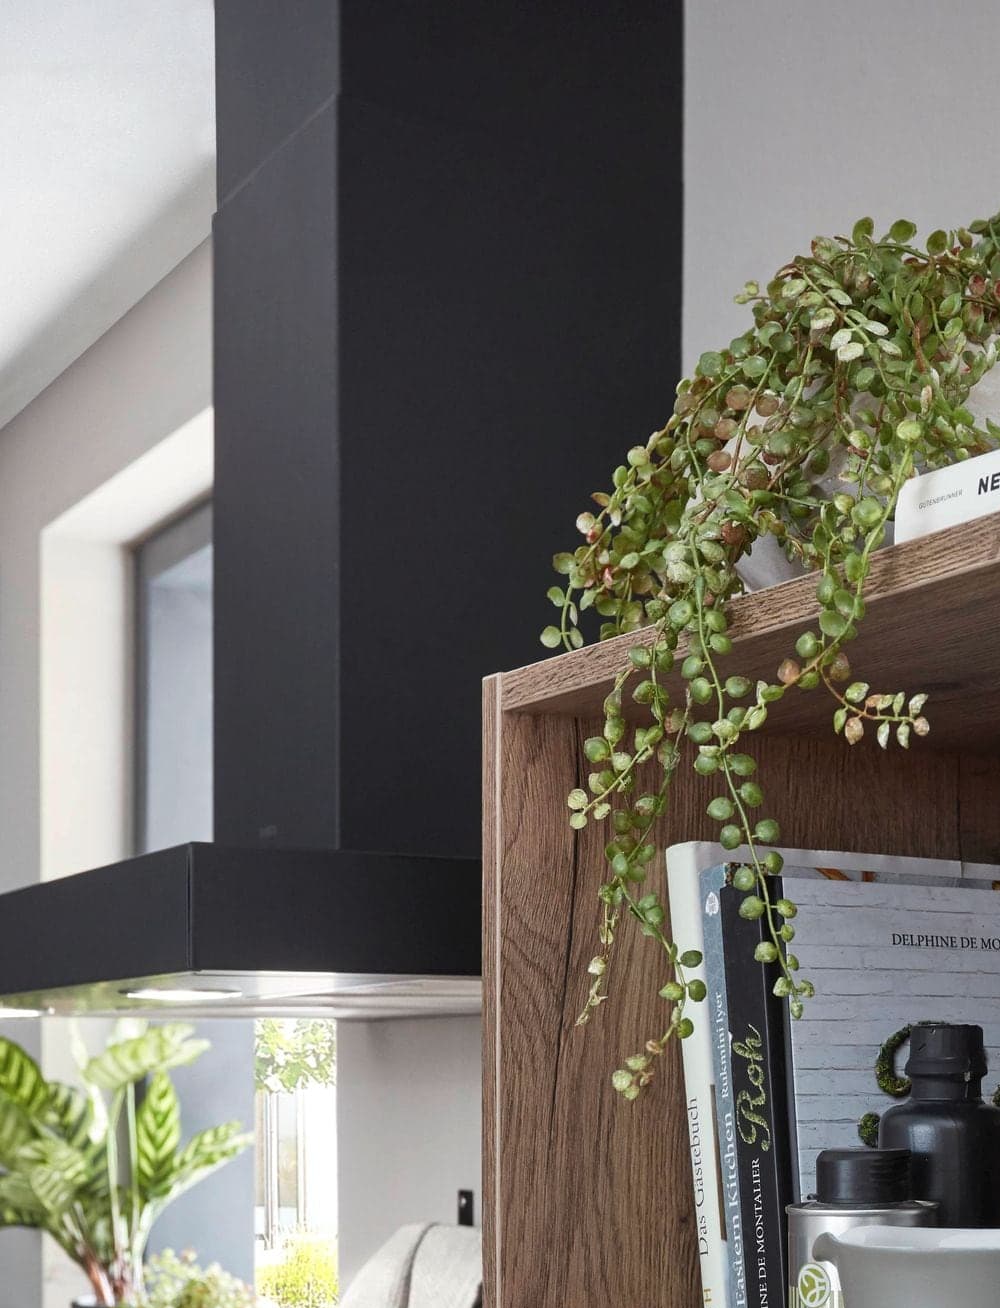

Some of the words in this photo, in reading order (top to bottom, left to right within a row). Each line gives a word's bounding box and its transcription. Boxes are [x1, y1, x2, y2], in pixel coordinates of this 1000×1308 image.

[891, 933, 958, 949] DELPHINE
[960, 936, 978, 950] DE
[715, 991, 727, 1024] Iyer
[718, 1030, 730, 1099] Rukmini
[732, 1023, 771, 1152] Roh
[723, 1112, 739, 1208] Kitchen
[699, 1215, 709, 1257] Das
[752, 1157, 767, 1252] MONTALIER
[731, 1214, 747, 1307] Eastern
[756, 1256, 767, 1279] DE
